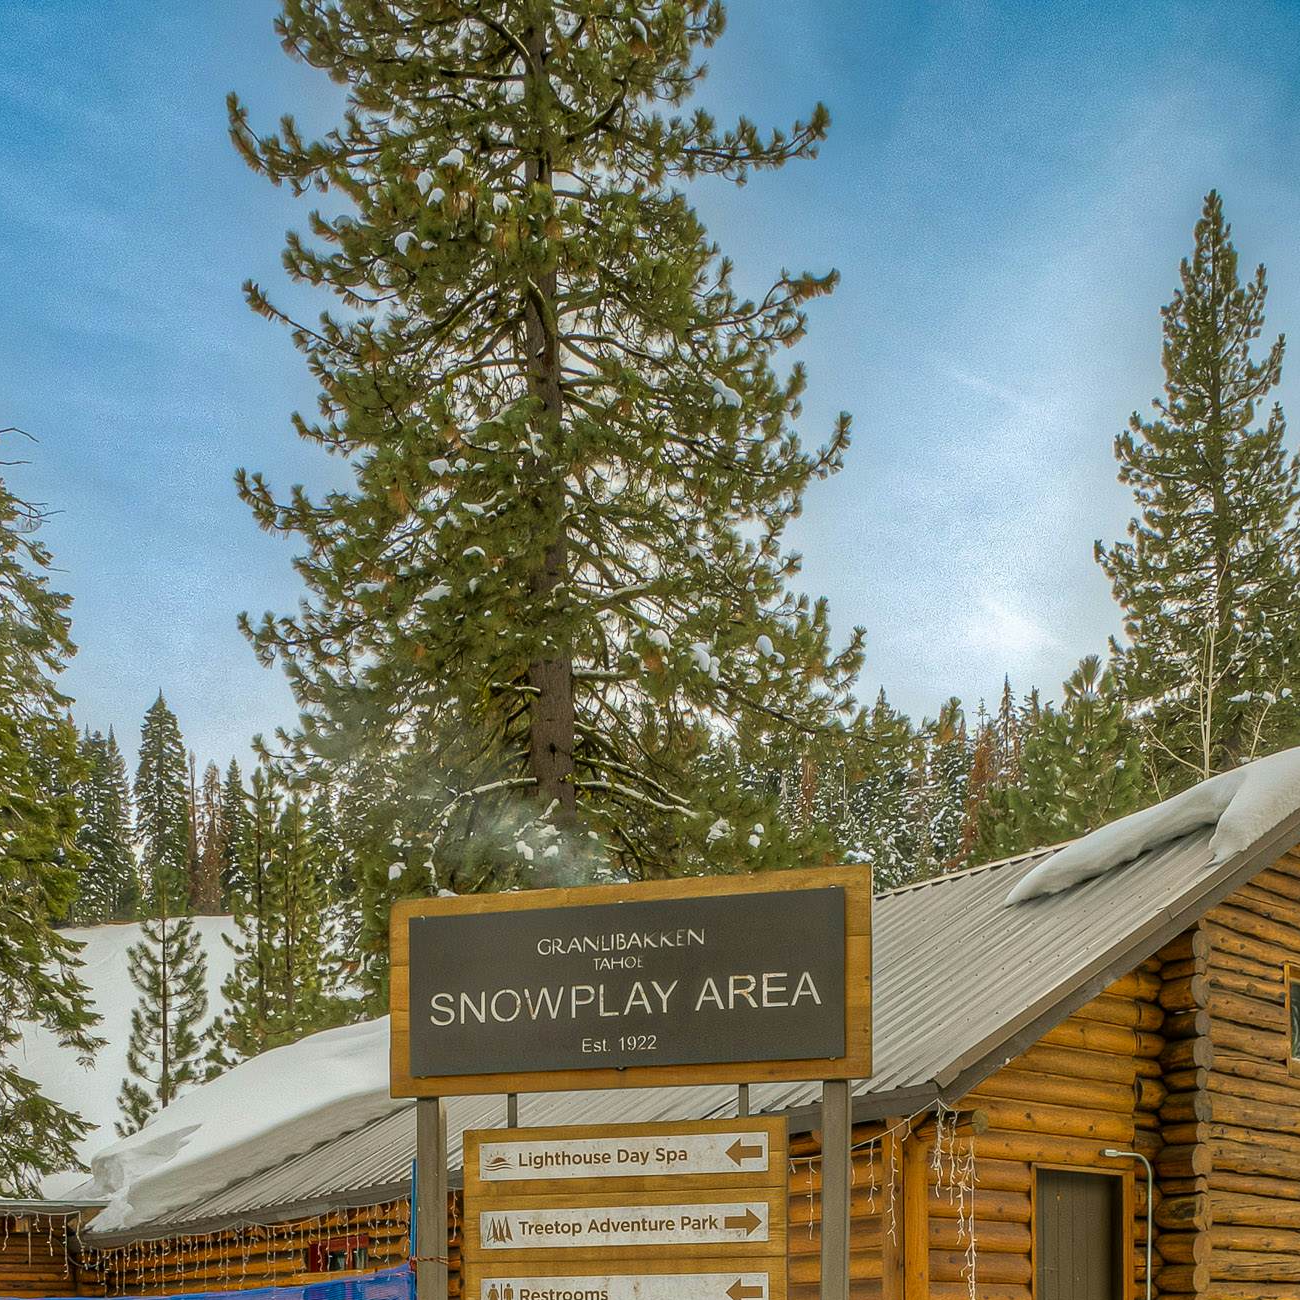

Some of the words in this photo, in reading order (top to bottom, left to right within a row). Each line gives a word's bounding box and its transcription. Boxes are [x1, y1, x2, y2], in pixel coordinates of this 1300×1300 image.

[536, 928, 706, 956] GRANLIBAKKEN
[593, 955, 644, 971] TAHOE
[429, 978, 679, 1027] SNOWPLAY
[694, 970, 822, 1012] AREA
[581, 1037, 611, 1053] Est.
[618, 1035, 658, 1052] 1922
[518, 1151, 611, 1169] Lighthouse
[617, 1148, 650, 1167] Day
[655, 1147, 688, 1165] Spa
[518, 1219, 582, 1237] Treetop
[587, 1216, 675, 1234] Adventure
[680, 1214, 718, 1231] Park
